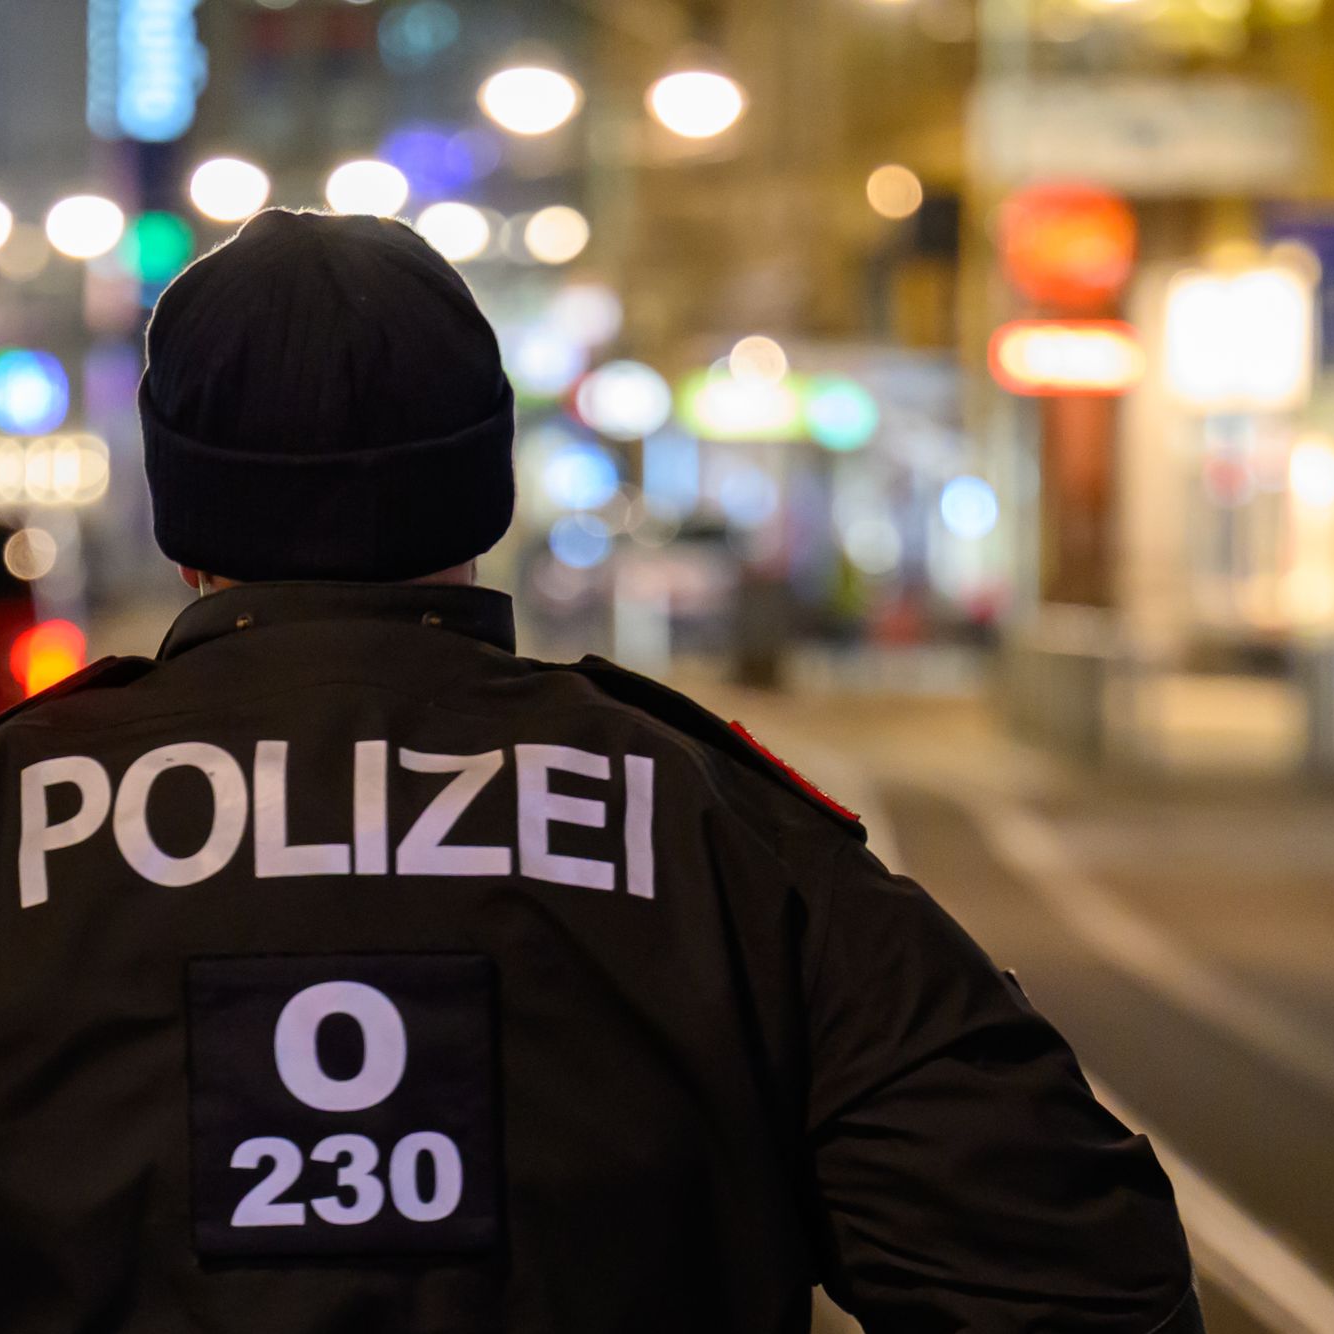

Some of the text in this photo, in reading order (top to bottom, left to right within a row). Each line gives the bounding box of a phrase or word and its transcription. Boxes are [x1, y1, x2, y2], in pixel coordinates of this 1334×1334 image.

[19, 740, 654, 908] POLIZEI
[274, 981, 407, 1112] O
[230, 1131, 463, 1226] 230
